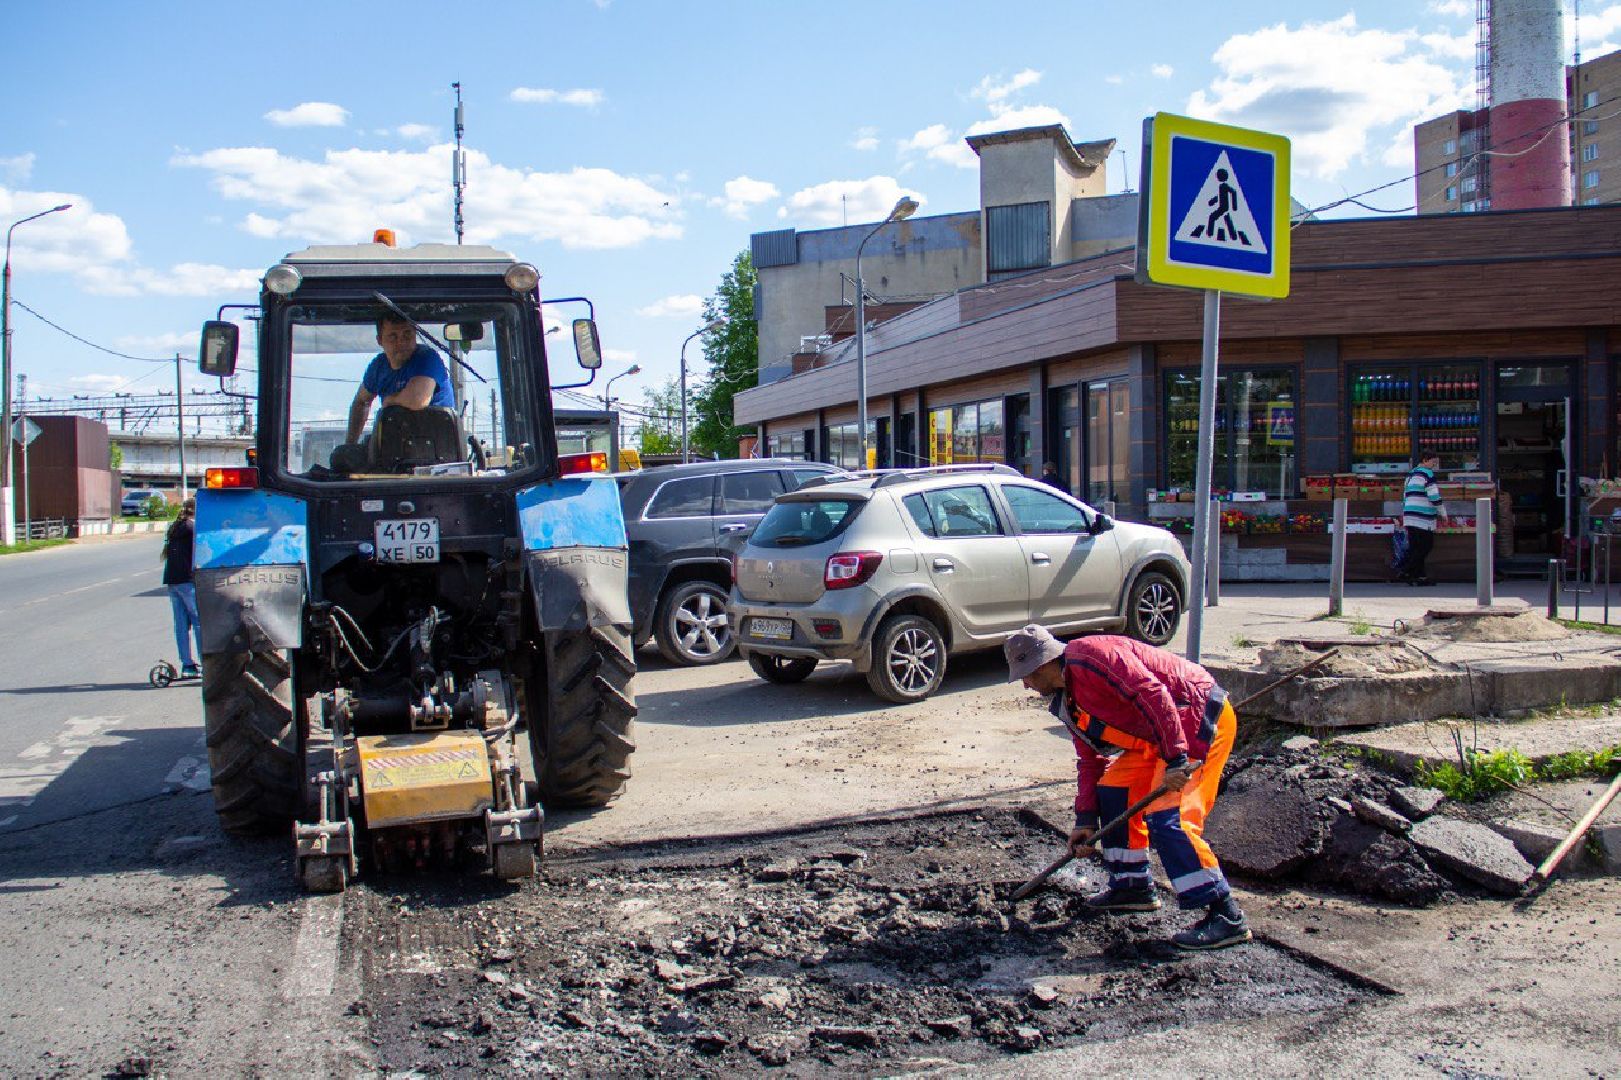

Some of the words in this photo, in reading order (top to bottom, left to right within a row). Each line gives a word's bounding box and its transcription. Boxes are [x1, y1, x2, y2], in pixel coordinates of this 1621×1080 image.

[383, 522, 431, 540] 4179
[415, 545, 435, 560] 50
[541, 554, 624, 569] ELARUS
[206, 571, 299, 588] ELARUS
